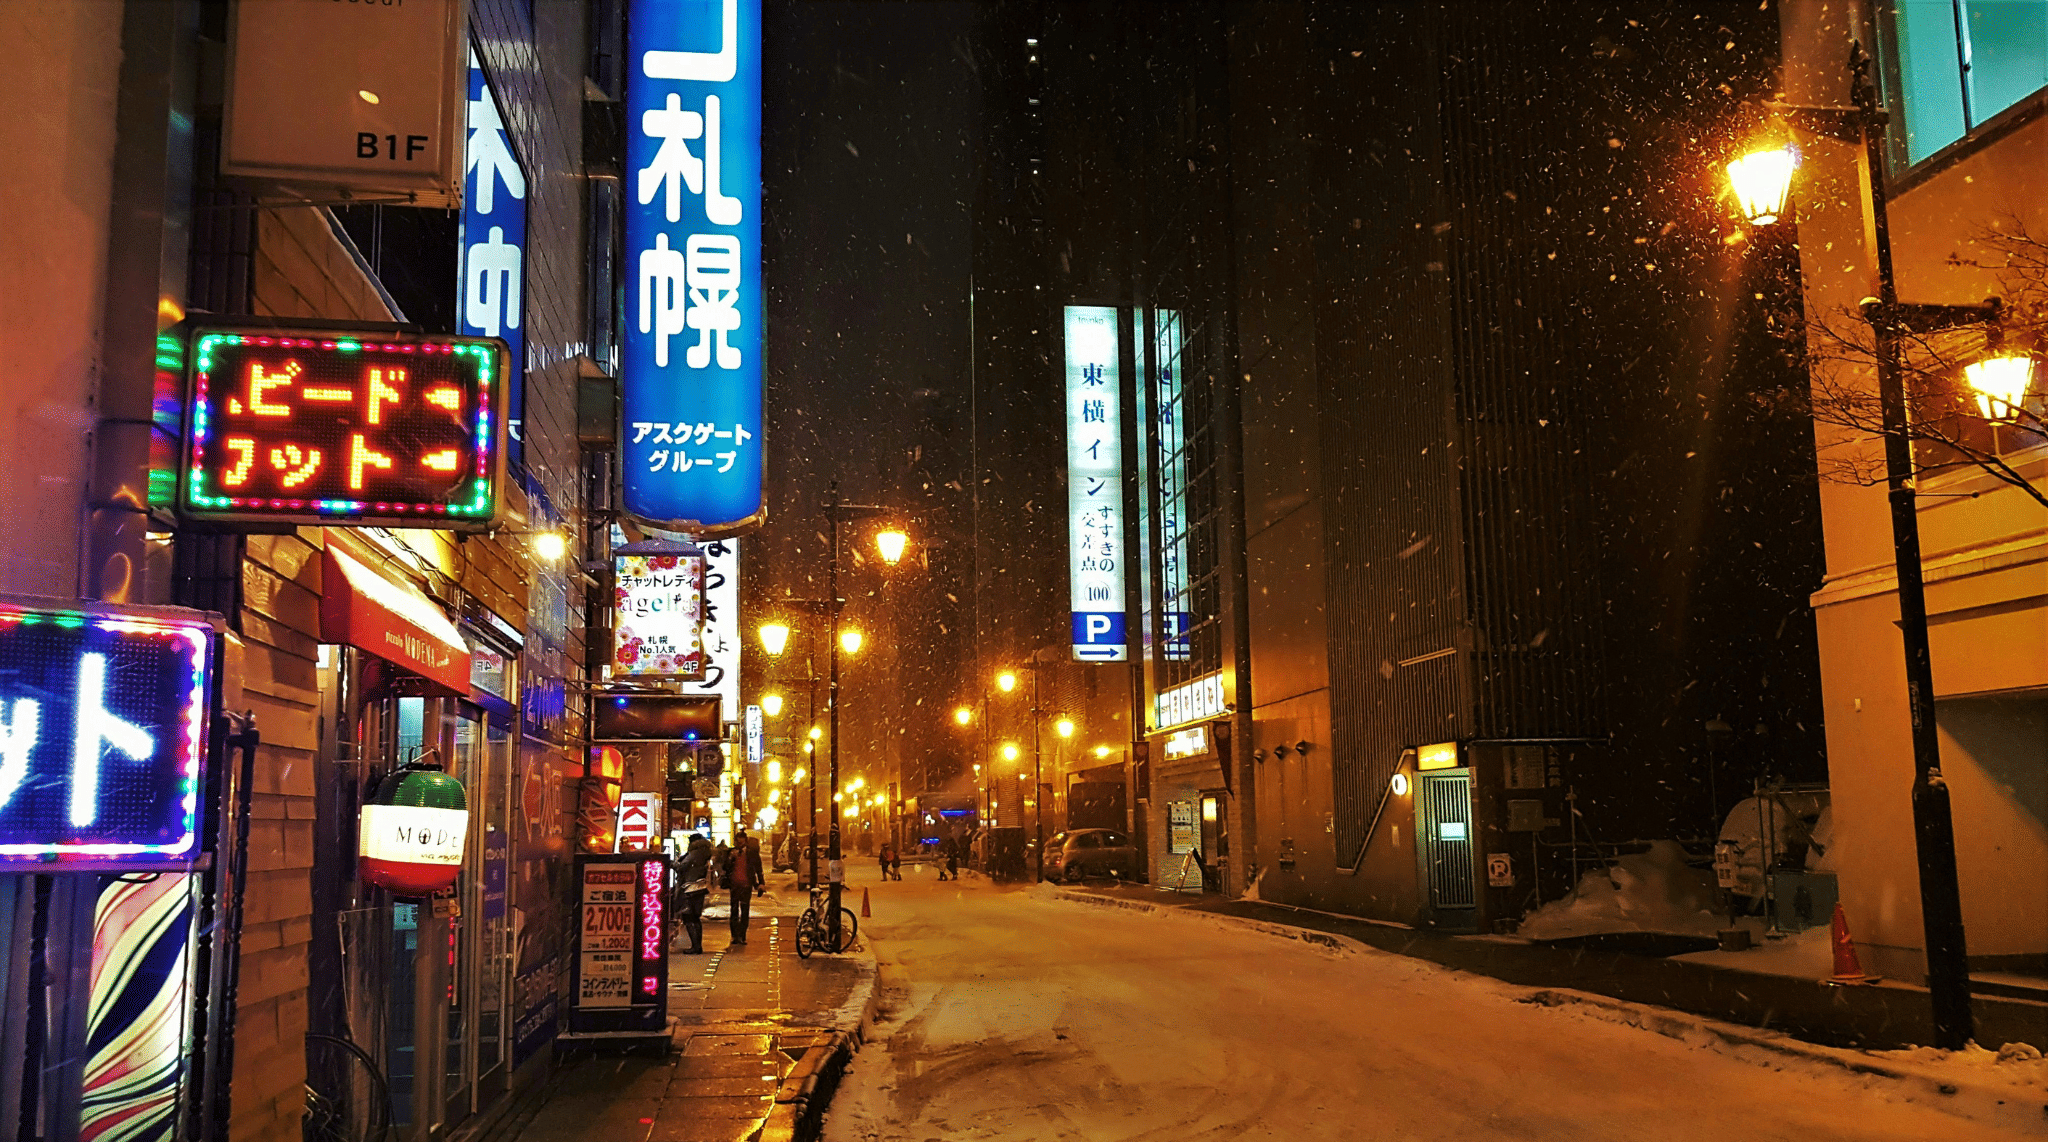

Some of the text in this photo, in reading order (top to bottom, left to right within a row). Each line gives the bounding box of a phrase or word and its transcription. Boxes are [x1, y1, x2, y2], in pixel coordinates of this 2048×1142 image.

[357, 132, 428, 159] B1F
[632, 422, 752, 446] アスクゲート
[1081, 362, 1106, 496] 東横イン
[648, 450, 737, 474] グループ
[1081, 512, 1097, 572] 交差点
[1097, 505, 1115, 573] すすきの
[621, 575, 695, 588] チャットレディ
[1088, 586, 1109, 602] 100
[648, 636, 668, 645] 札幌
[1086, 614, 1112, 643] P
[404, 632, 436, 669] MODENA
[639, 645, 677, 655] No.1人気
[682, 661, 699, 673] 4F
[590, 890, 627, 901] ご宿泊
[642, 860, 663, 959] 持ち込みOK
[582, 976, 629, 990] コインランドリー
